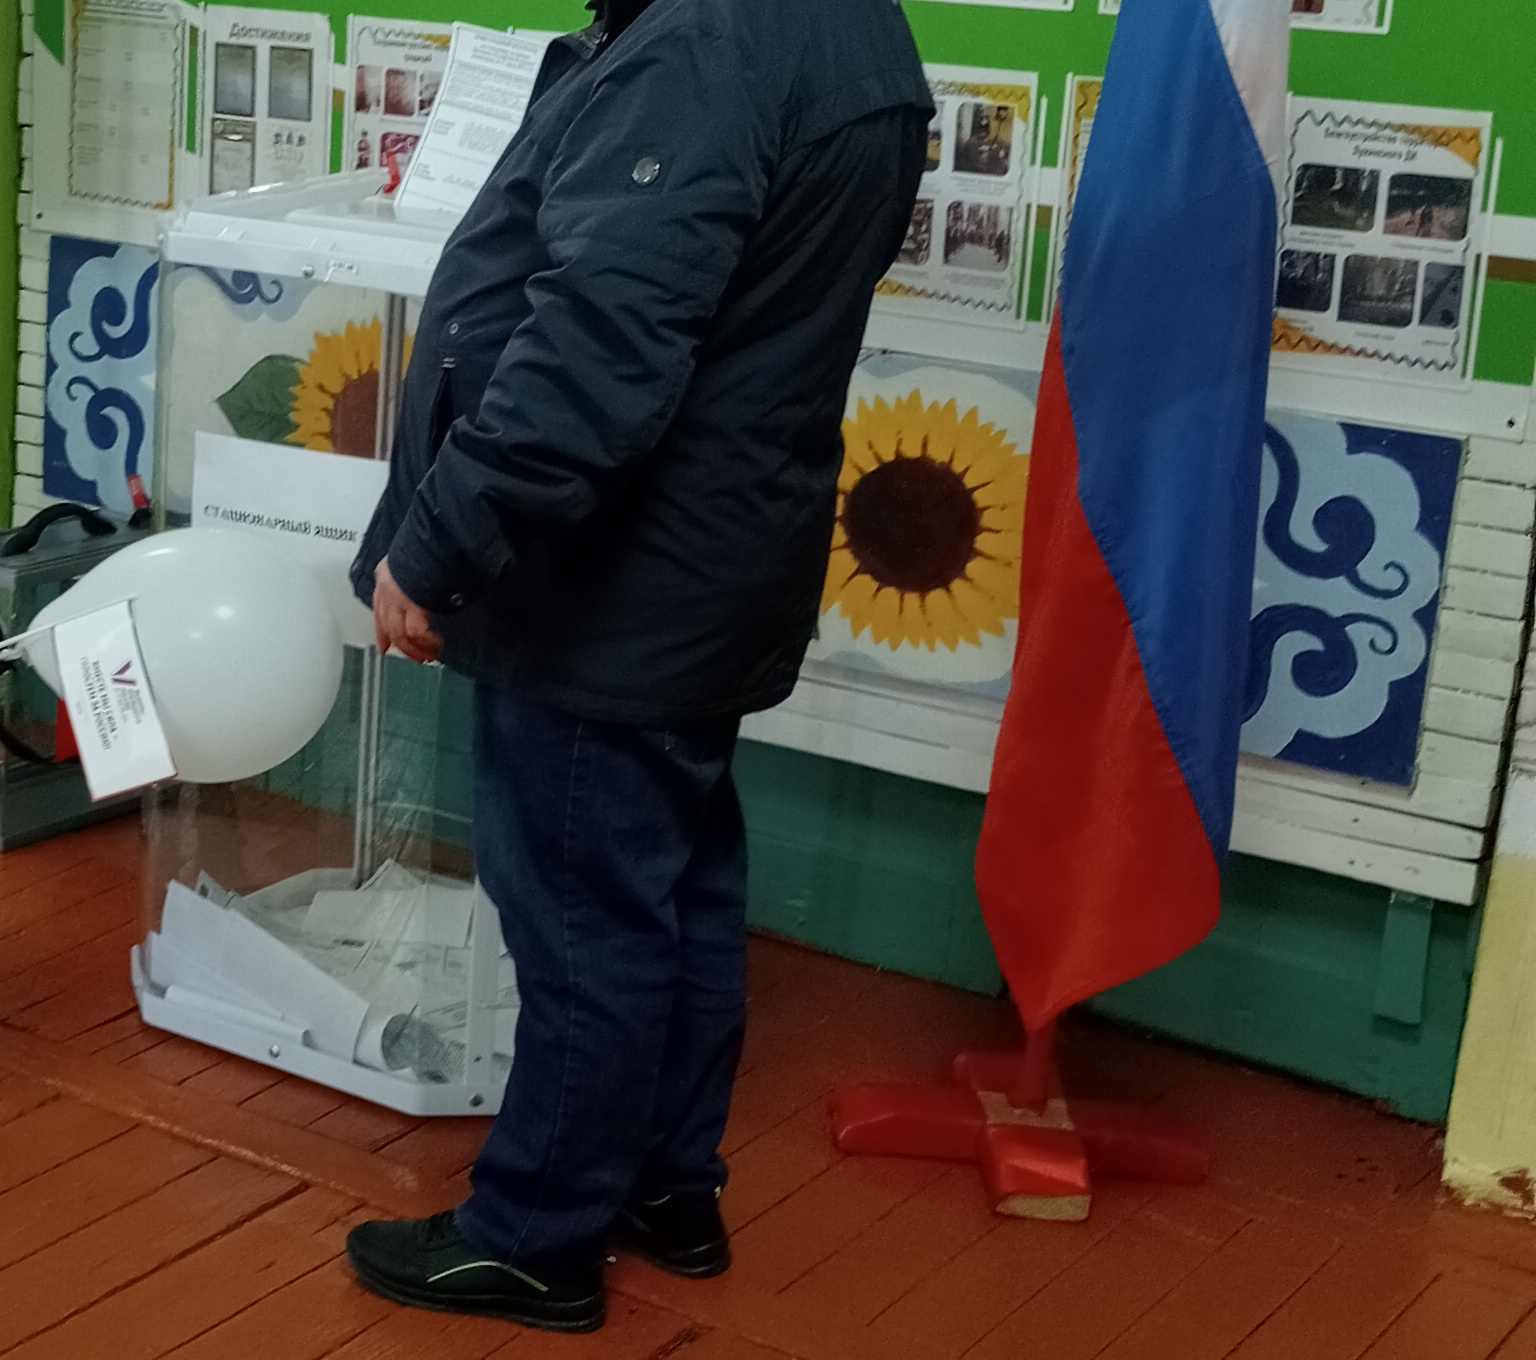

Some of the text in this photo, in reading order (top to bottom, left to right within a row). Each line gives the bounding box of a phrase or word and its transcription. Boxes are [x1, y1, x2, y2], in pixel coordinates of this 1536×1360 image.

[228, 22, 312, 44] Достижения
[203, 503, 359, 543] СТАЦИОНАРНЫЙ ЯЩИК
